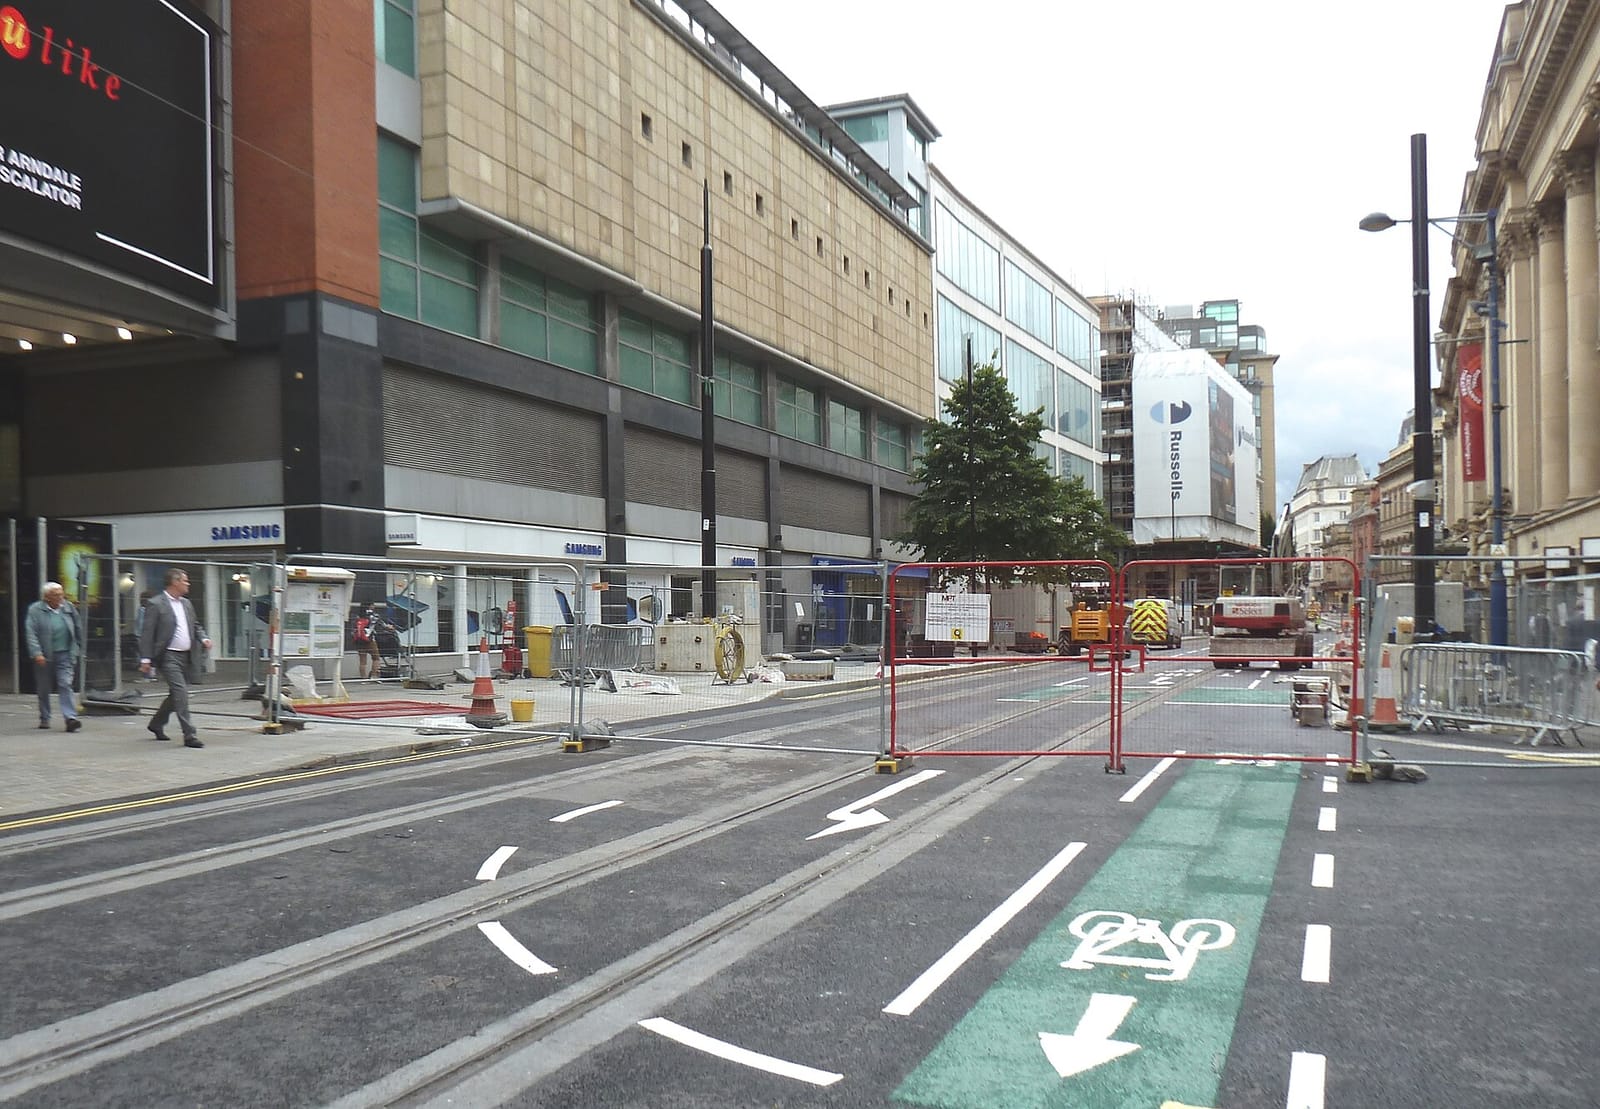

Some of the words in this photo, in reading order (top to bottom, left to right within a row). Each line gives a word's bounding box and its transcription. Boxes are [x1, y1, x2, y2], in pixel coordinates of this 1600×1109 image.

[41, 25, 121, 100] like
[7, 149, 82, 192] ARNDALE
[1171, 430, 1183, 500] Russells
[211, 524, 280, 541] SAMSUNG
[388, 533, 415, 541] SAMSUNG
[565, 542, 602, 556] SAMSUNG
